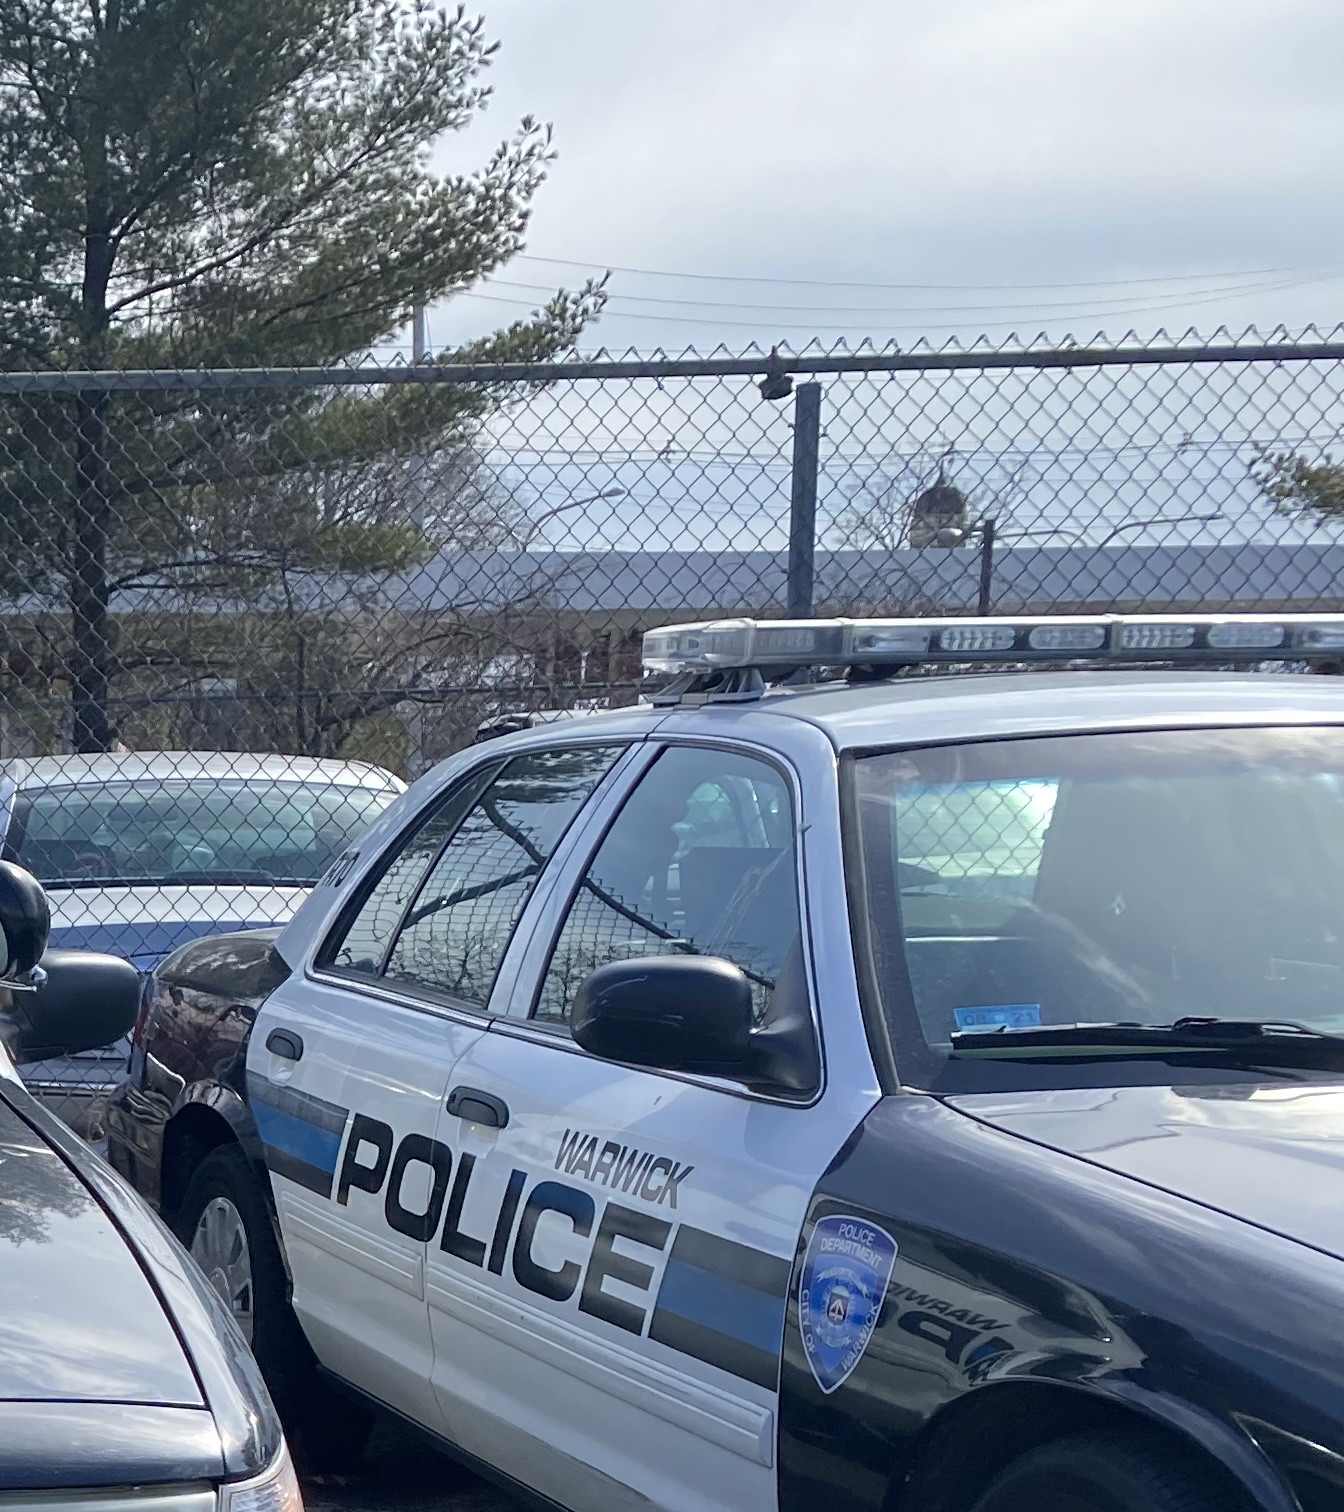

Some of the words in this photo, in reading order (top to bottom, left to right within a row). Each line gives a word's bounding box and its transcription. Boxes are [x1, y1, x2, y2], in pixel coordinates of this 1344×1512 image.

[1014, 1012, 1036, 1024] 21
[554, 1127, 696, 1210] WARWICK
[337, 1112, 673, 1337] POLICE
[838, 1223, 876, 1247] POLICE
[820, 1238, 883, 1270] DEPARTMENT
[801, 1289, 811, 1331] CITY
[841, 1303, 879, 1372] WARWICK
